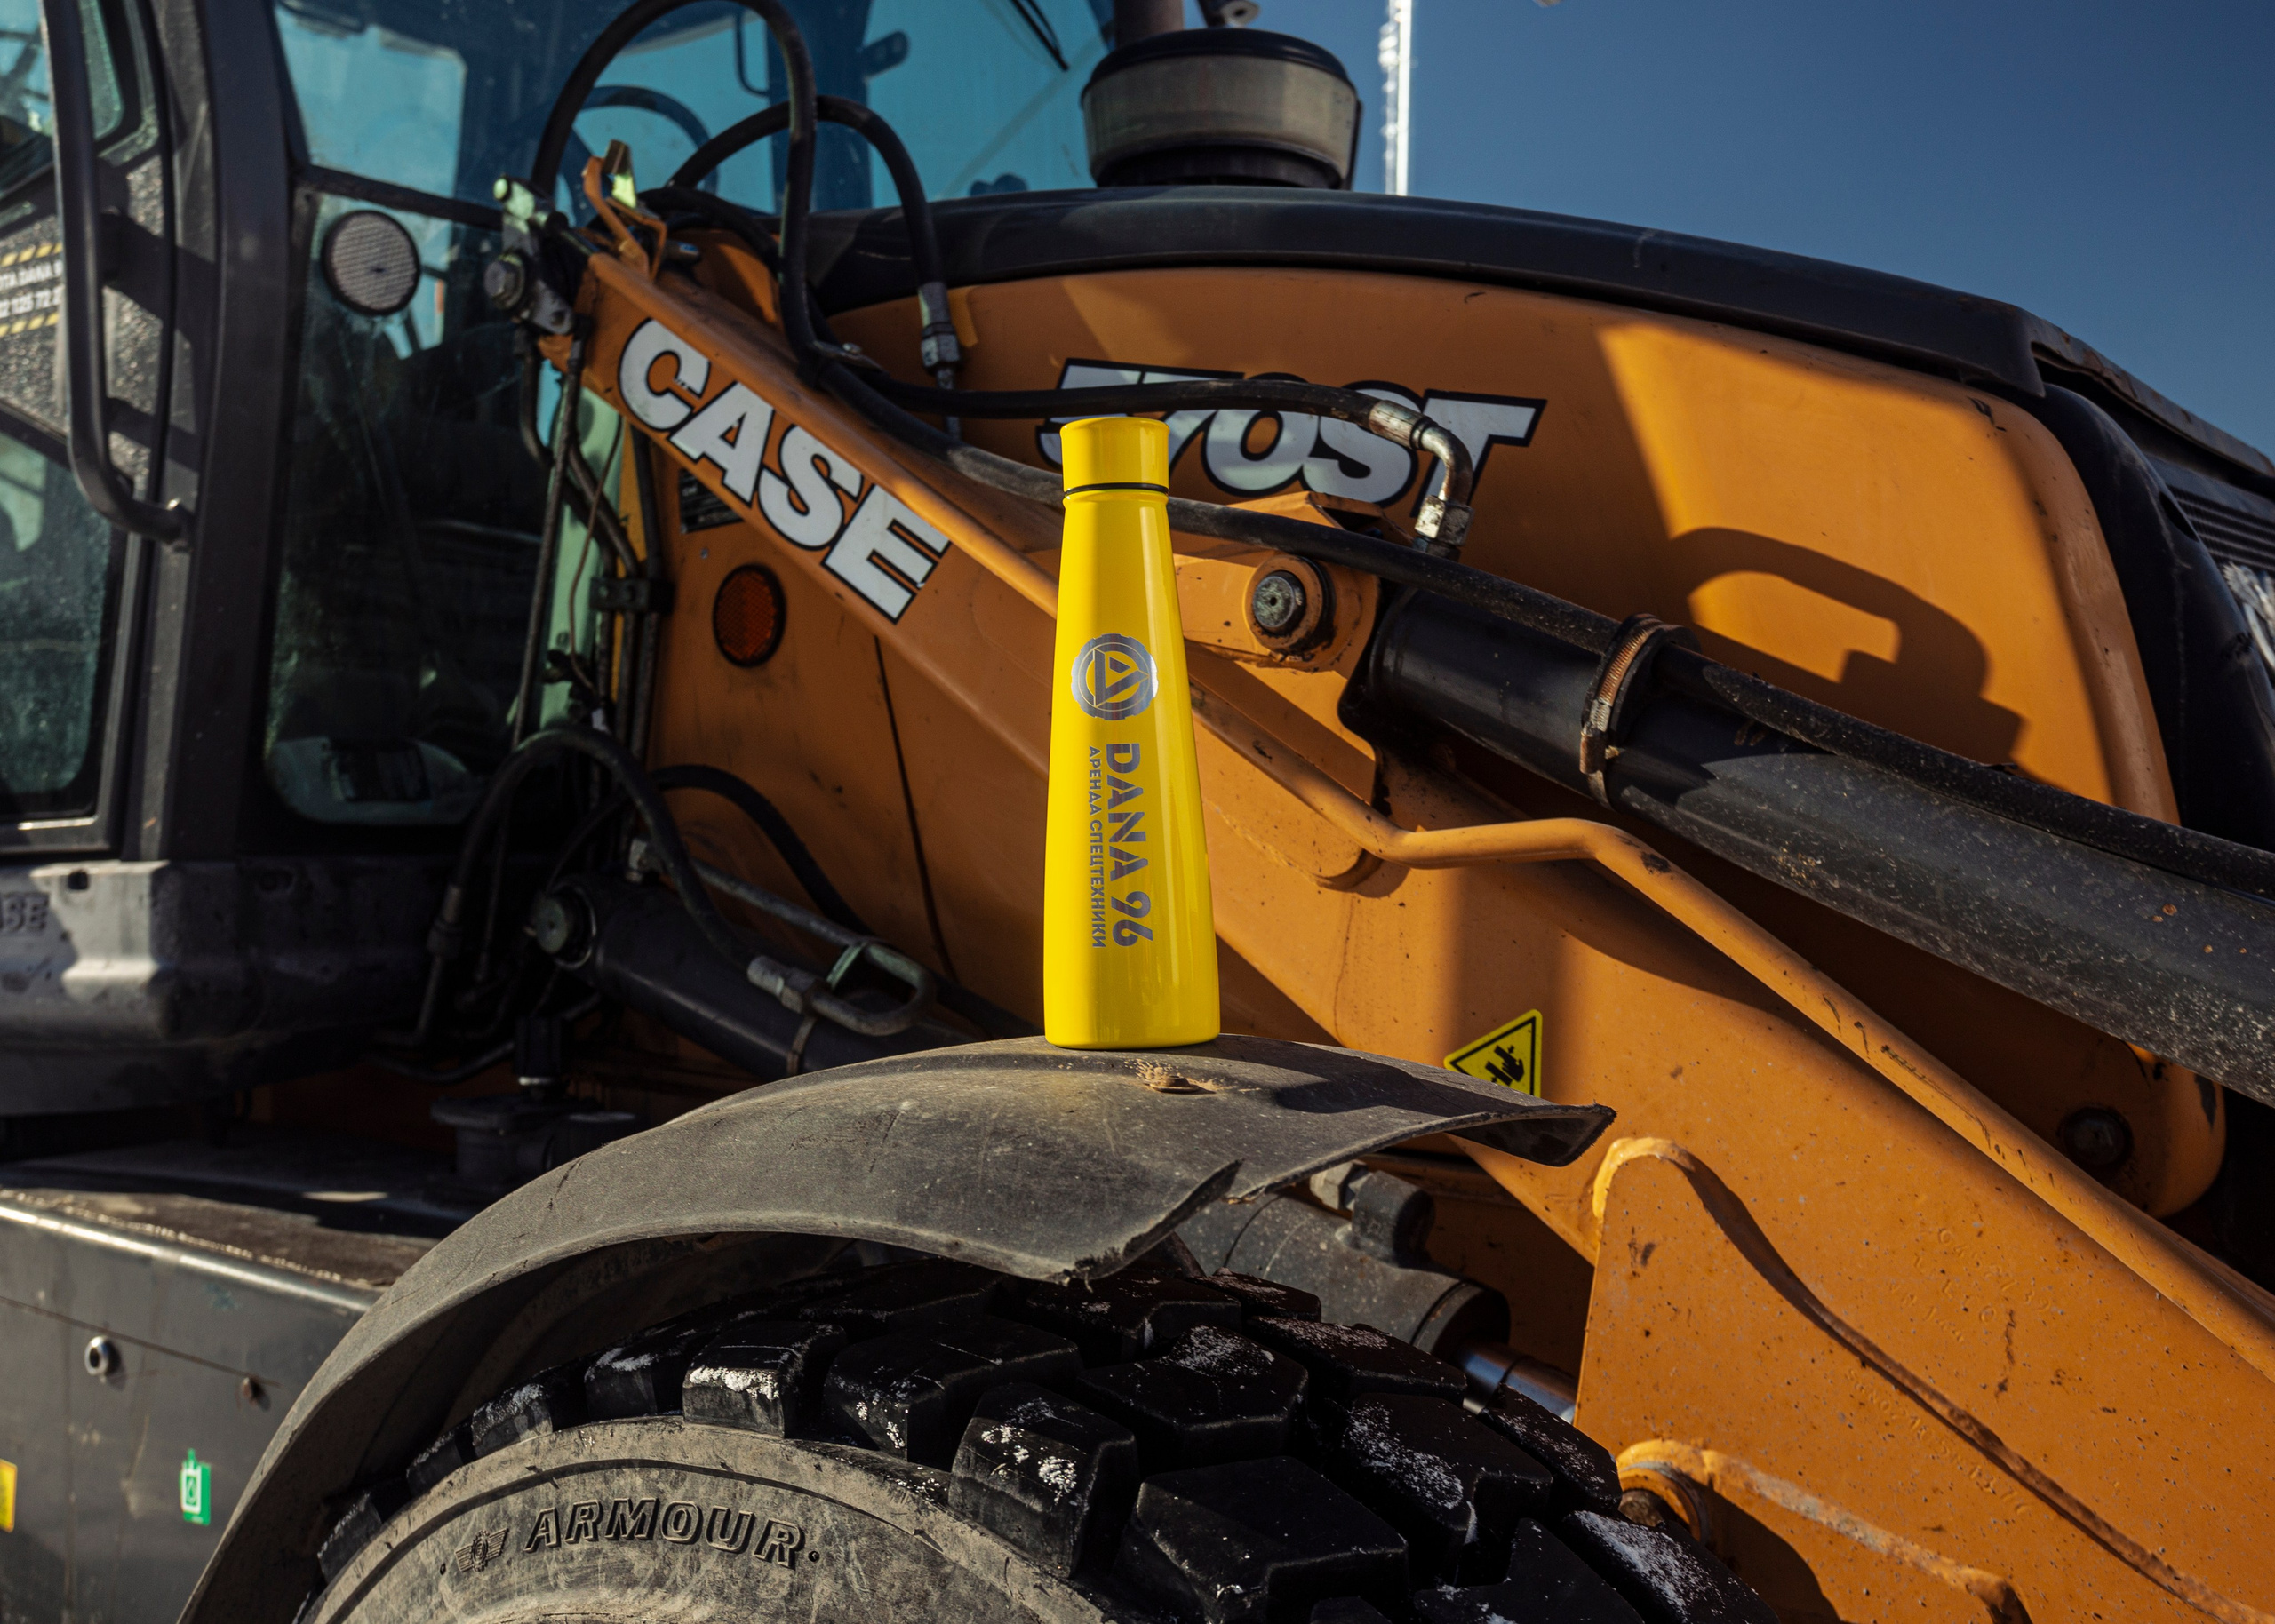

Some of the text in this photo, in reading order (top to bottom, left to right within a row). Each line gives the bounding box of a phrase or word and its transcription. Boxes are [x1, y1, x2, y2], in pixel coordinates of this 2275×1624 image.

[618, 316, 951, 625] CASE
[1089, 745, 1107, 949] АРЕНДА СПЕЦТЕХНИКИ
[1106, 743, 1153, 947] DANA 96
[523, 1496, 806, 1570] ARMOUR
